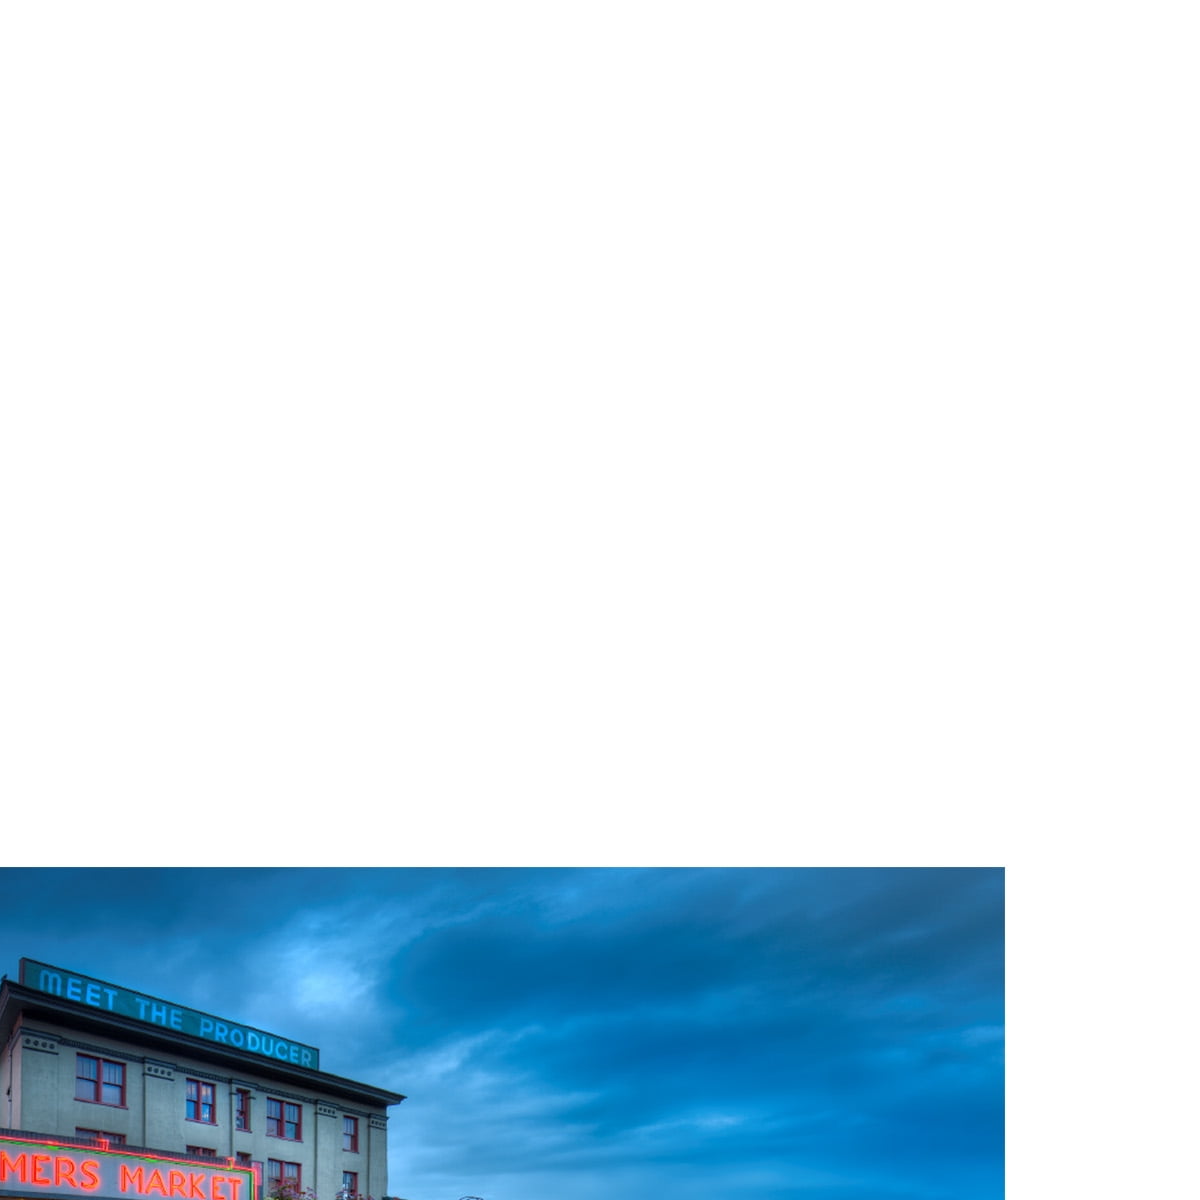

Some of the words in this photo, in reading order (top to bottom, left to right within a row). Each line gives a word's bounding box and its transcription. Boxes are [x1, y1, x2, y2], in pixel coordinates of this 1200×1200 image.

[38, 969, 119, 1011] MEET
[135, 996, 183, 1031] THE
[199, 1017, 313, 1069] PRODUCER
